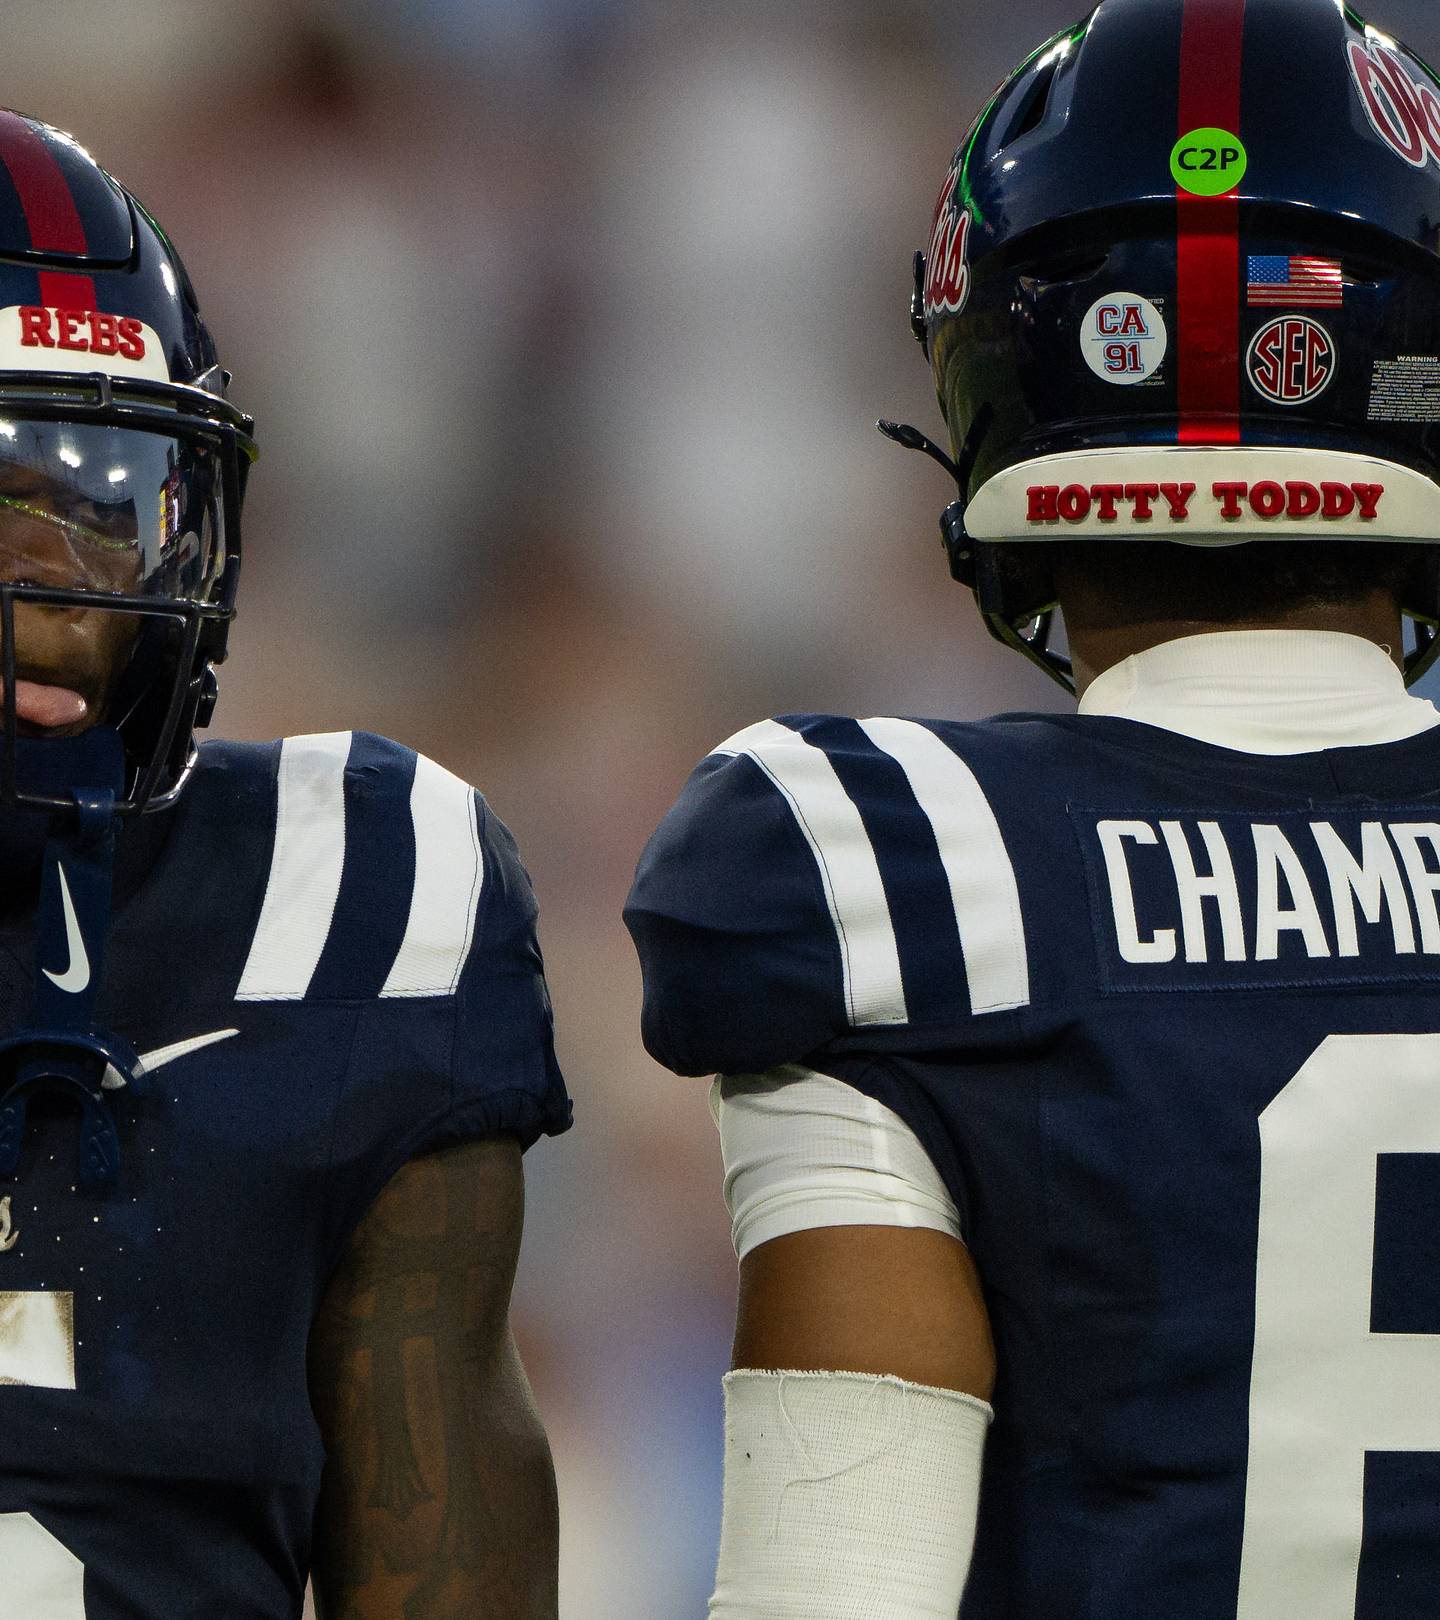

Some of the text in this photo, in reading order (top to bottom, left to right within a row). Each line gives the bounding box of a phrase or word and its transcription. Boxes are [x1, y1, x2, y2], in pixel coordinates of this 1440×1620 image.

[1177, 147, 1240, 171] C2P
[18, 305, 146, 361] REBS
[1096, 304, 1148, 337] CA
[1103, 341, 1144, 374] 91
[1254, 320, 1329, 398] SEC
[1026, 481, 1384, 521] HOTTY TODDY
